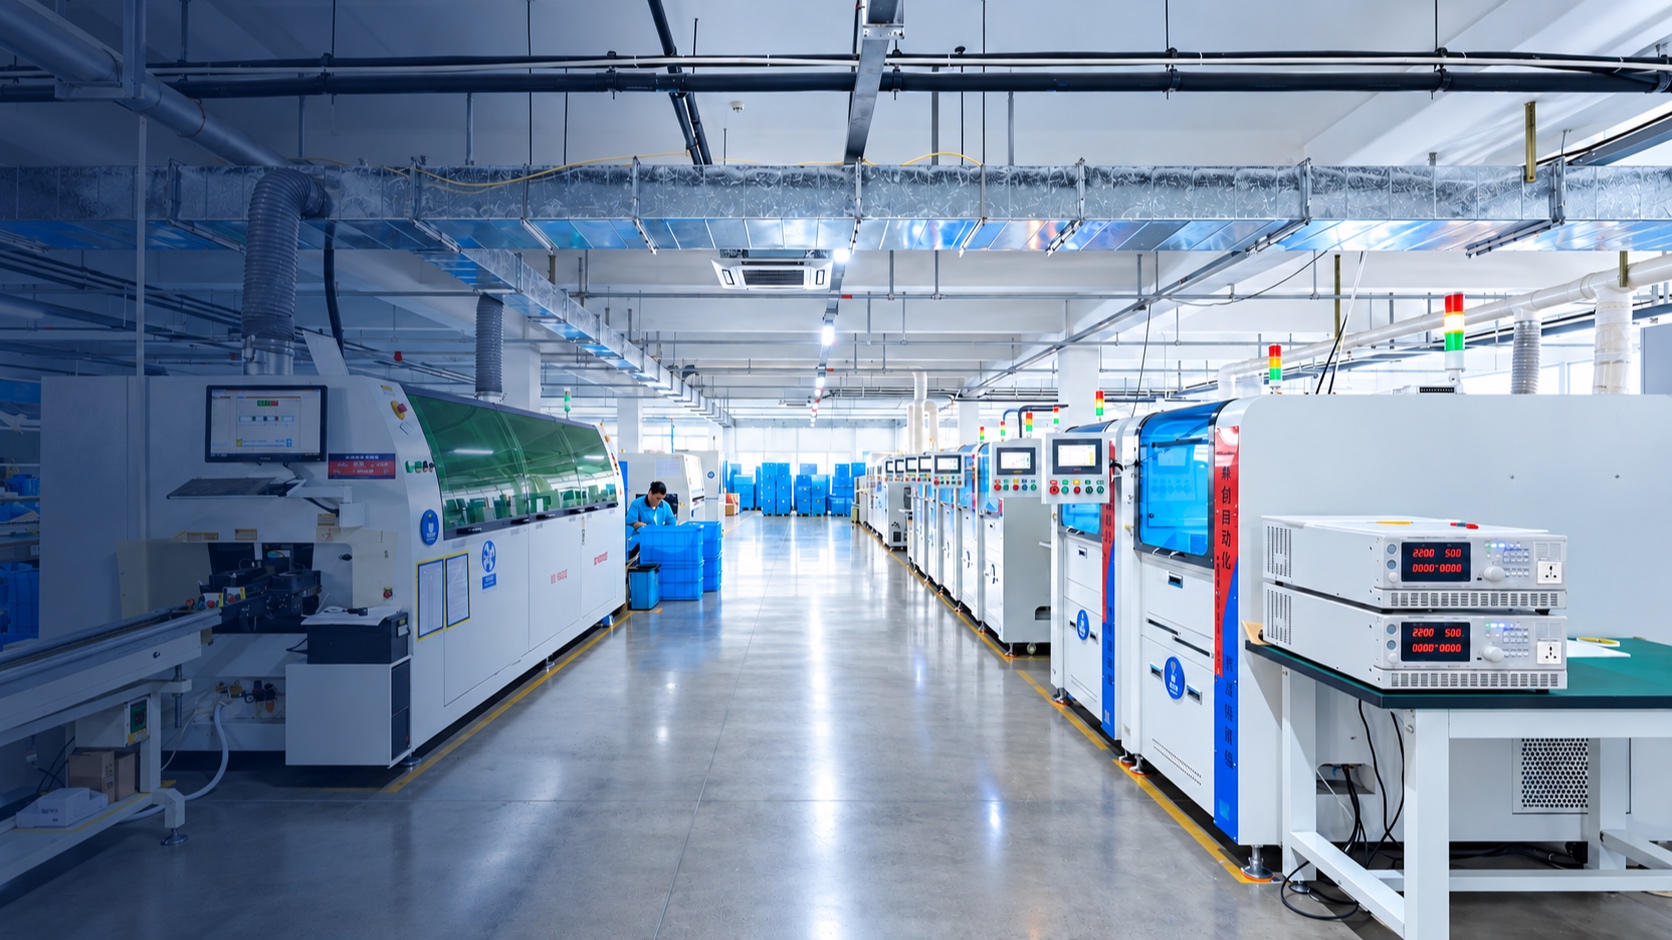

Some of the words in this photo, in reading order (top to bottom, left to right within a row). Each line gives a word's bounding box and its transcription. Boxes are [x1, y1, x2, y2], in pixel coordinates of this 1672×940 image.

[1412, 548, 1435, 558] 2200
[1445, 548, 1462, 558] 500
[1412, 628, 1435, 637] 2200
[1445, 628, 1462, 637] 500
